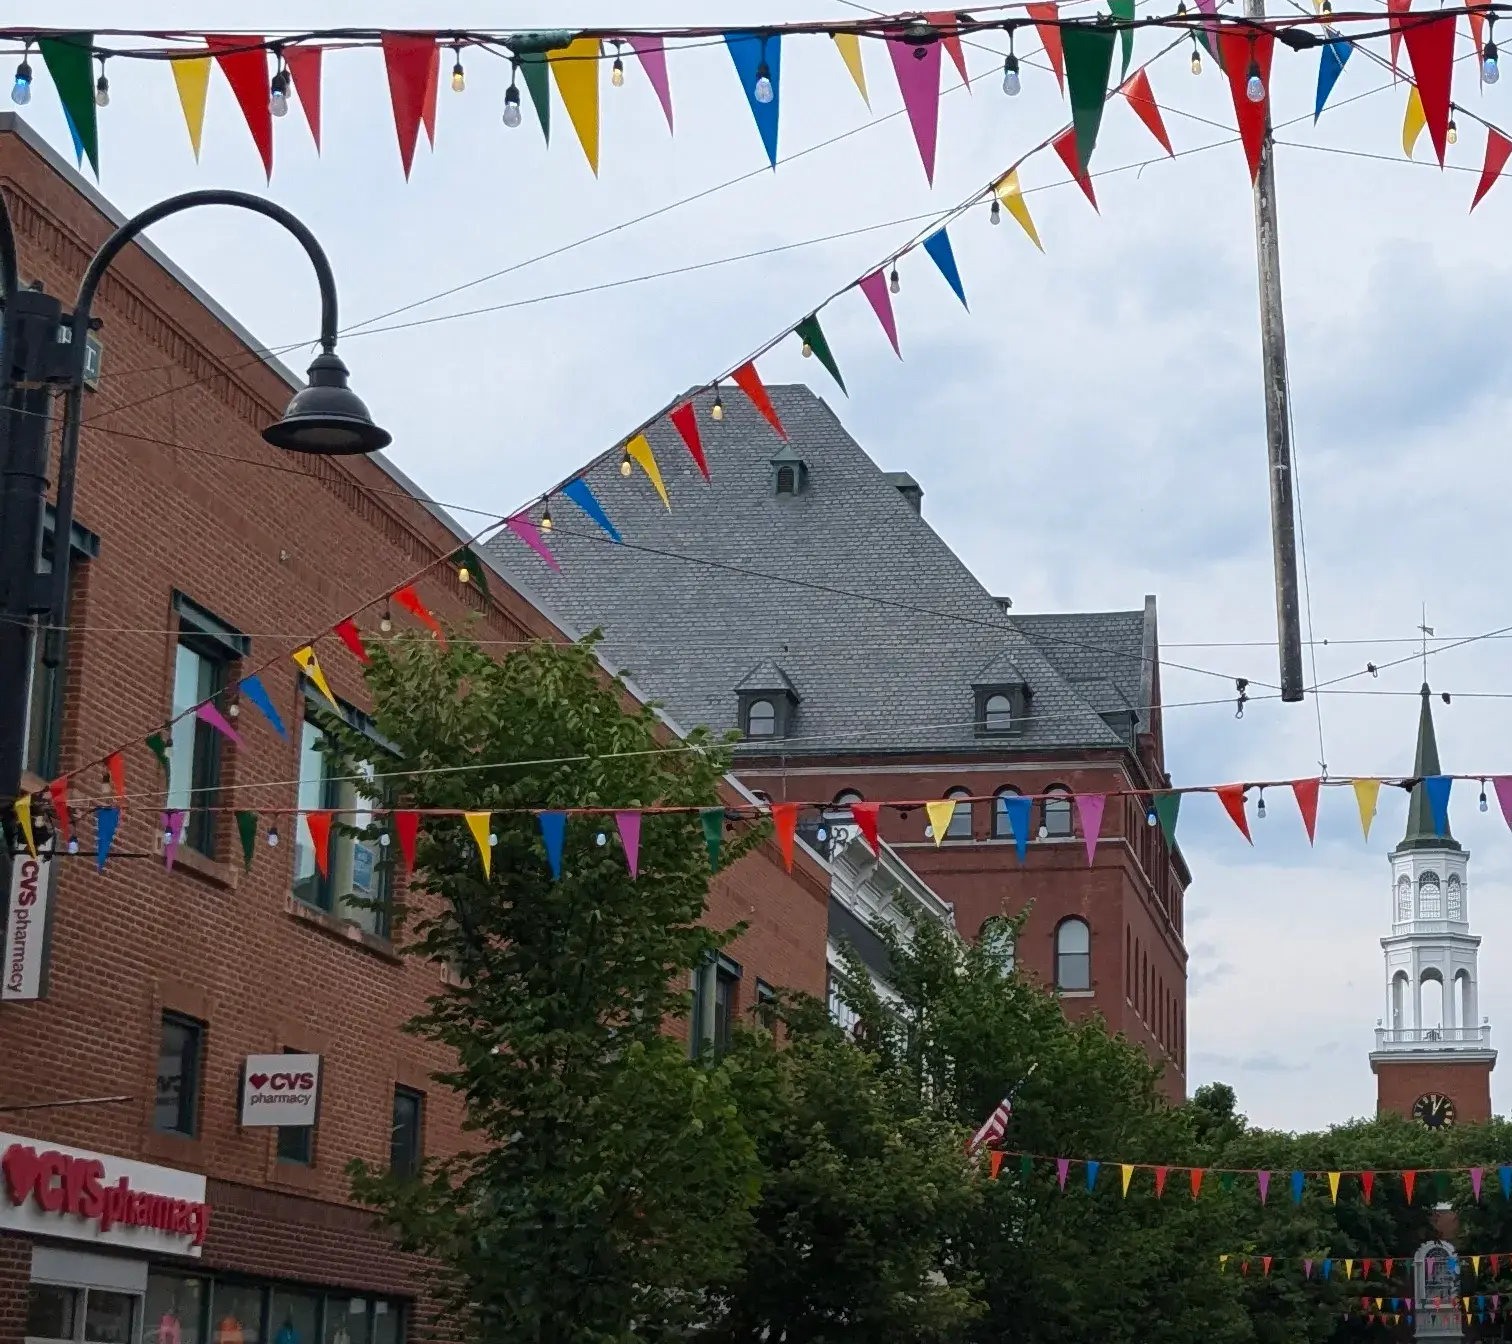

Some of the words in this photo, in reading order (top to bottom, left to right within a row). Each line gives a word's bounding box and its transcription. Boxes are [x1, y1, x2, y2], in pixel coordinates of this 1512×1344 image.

[18, 860, 39, 906] CVS
[7, 909, 32, 992] pharmacy
[250, 1093, 312, 1105] pharmacy
[270, 1072, 314, 1090] CVS
[34, 1149, 106, 1218] CVS
[100, 1176, 213, 1246] pharmacy
